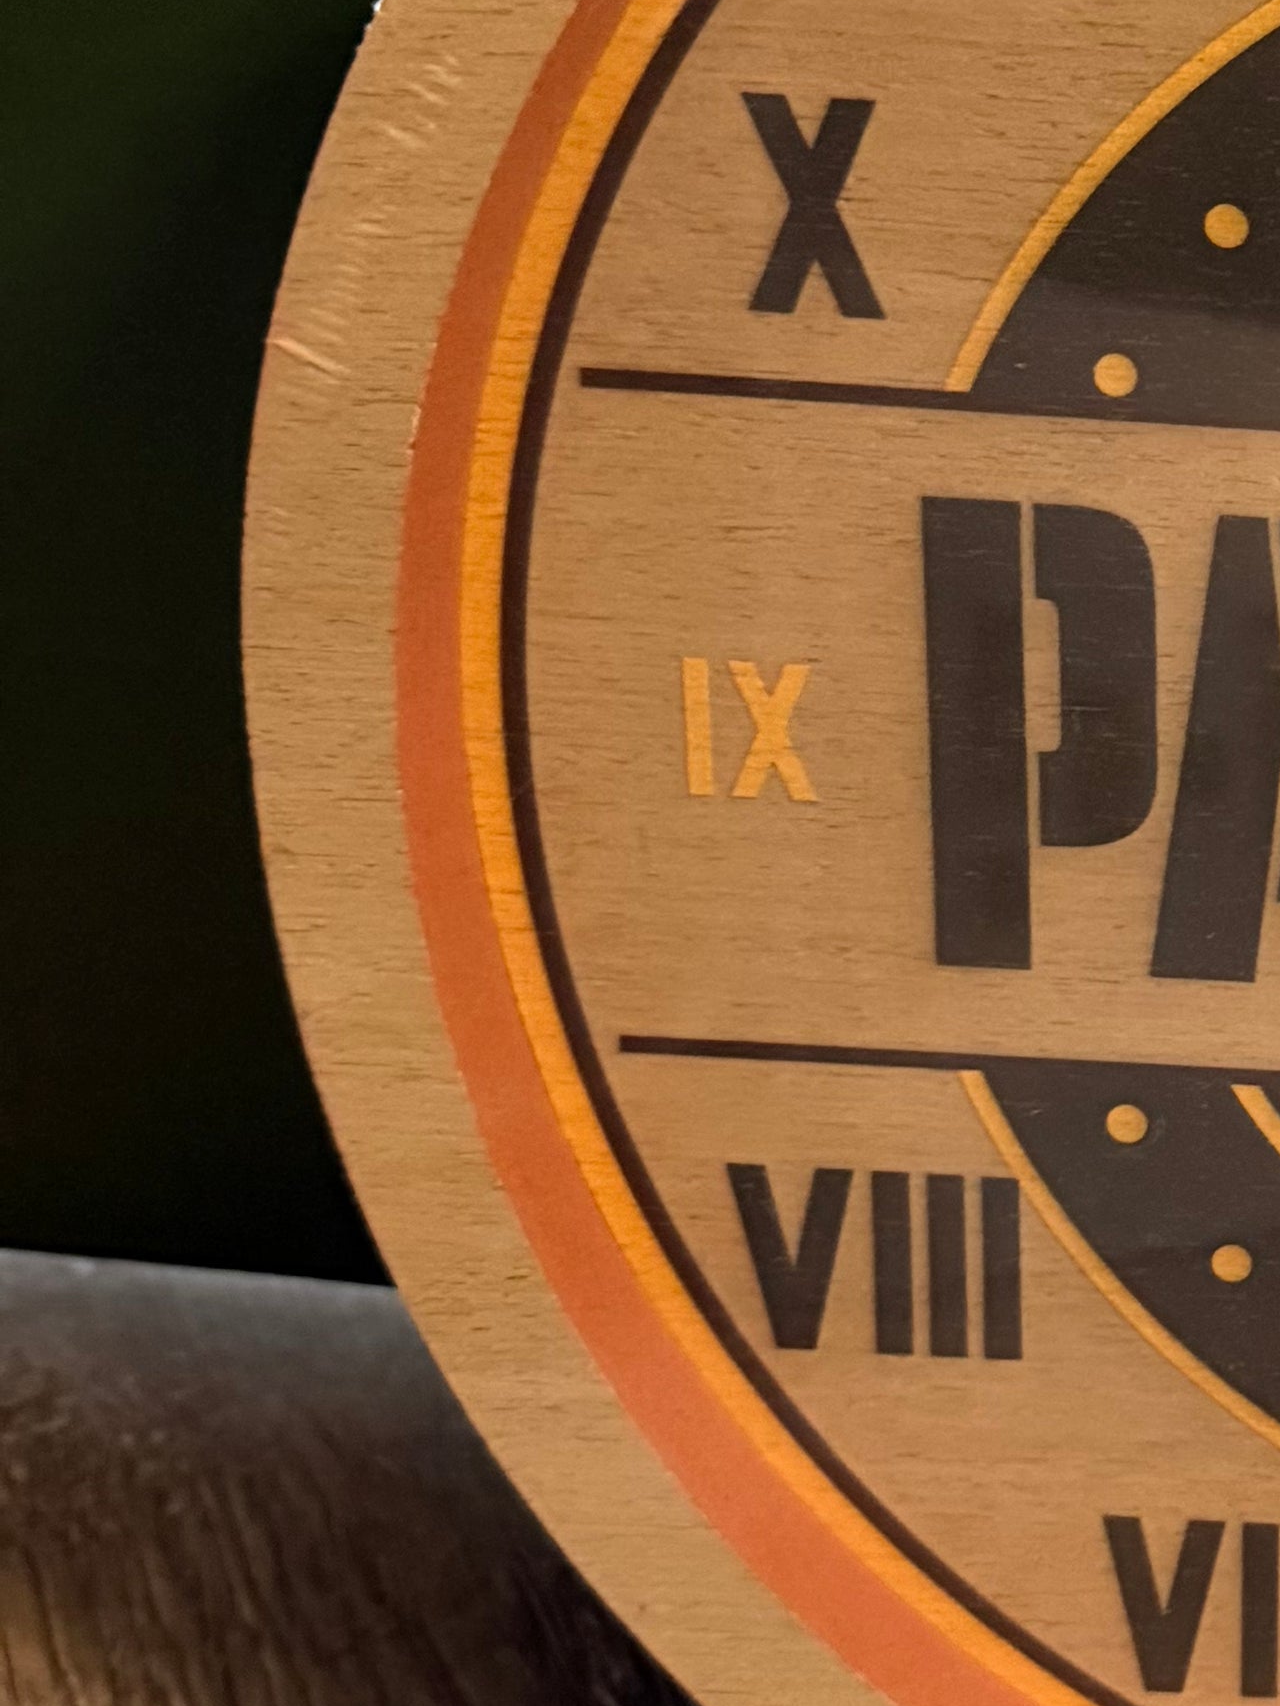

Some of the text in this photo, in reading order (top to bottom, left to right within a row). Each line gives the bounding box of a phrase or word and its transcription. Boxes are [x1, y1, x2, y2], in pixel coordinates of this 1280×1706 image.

[740, 91, 886, 320] X
[683, 657, 818, 802] IX
[726, 1163, 1023, 1361] VIII
